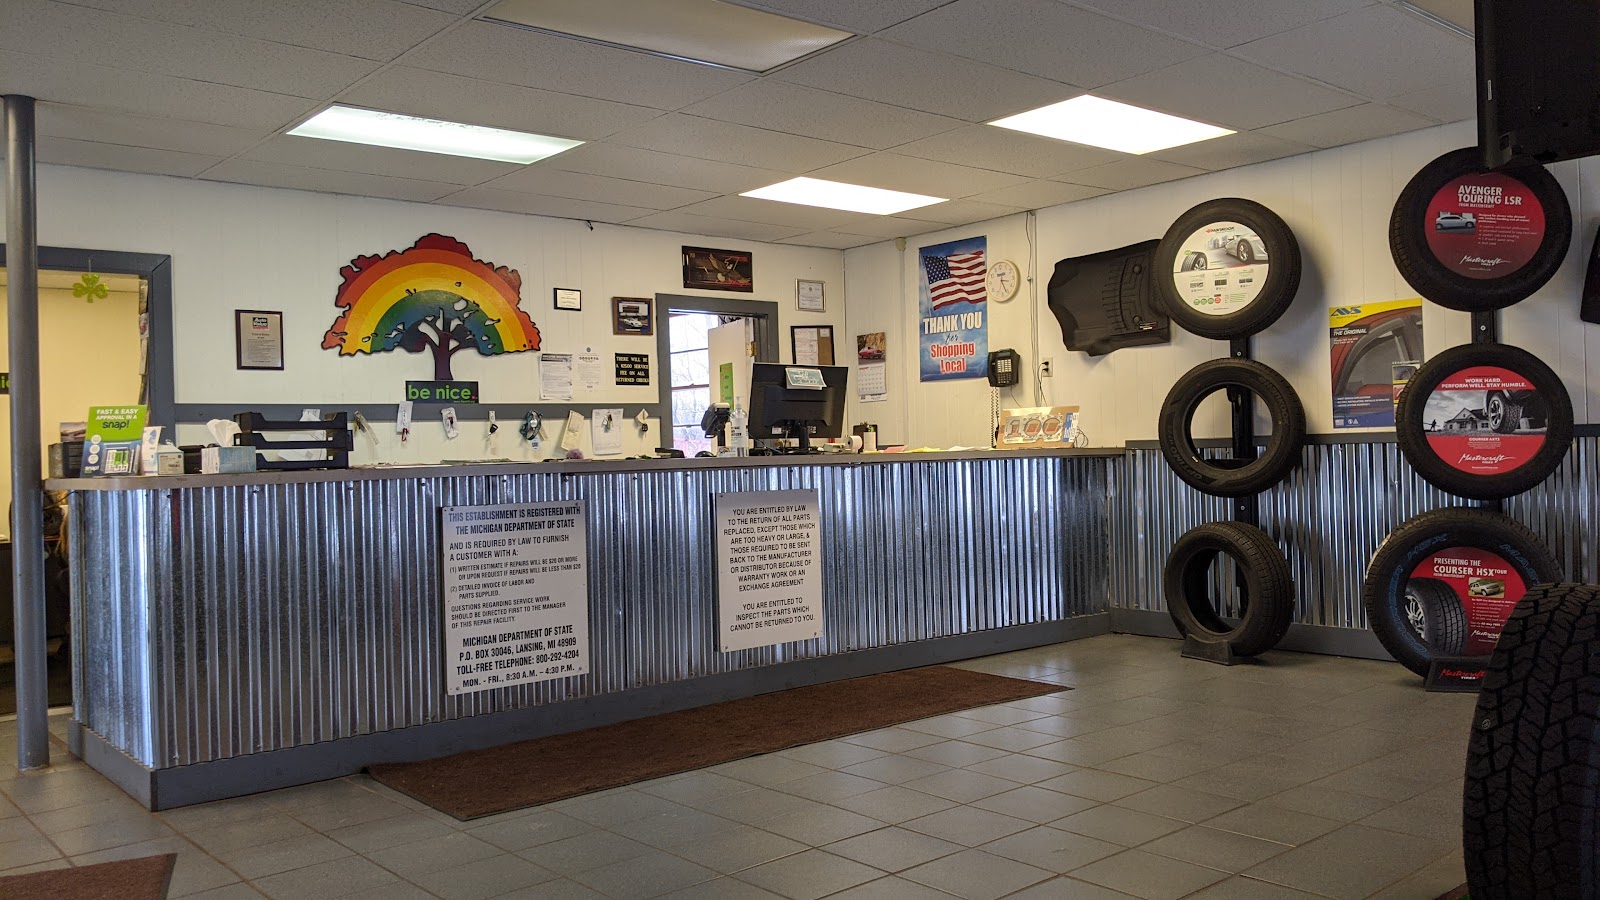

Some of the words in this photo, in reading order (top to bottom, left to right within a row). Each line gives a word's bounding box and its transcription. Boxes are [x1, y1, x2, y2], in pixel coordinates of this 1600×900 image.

[1458, 185, 1502, 196] AVENGER
[1458, 194, 1502, 204] TOURING
[1504, 196, 1522, 205] LSR
[1460, 254, 1510, 266] Mastercraft
[923, 314, 958, 334] THANK
[959, 311, 982, 330] YOU
[930, 342, 974, 359] Shopping
[940, 358, 966, 372] Local
[408, 384, 430, 399] be
[102, 420, 130, 430] snap!
[1458, 454, 1516, 464] Mastercraft
[449, 512, 463, 521] THIS
[465, 509, 517, 520] ESTABLISHMENT
[519, 508, 525, 517] IS
[526, 506, 563, 517] REGISTERED
[565, 506, 580, 515] WITH
[456, 525, 468, 534] THE
[470, 523, 502, 534] MICHIGAN
[504, 520, 545, 531] DEPARTMENT
[547, 520, 555, 528] OF
[556, 518, 574, 528] STATE
[723, 527, 755, 535] REPLACED,
[449, 542, 463, 550] AND
[473, 539, 506, 548] REQUIRED
[542, 534, 569, 543] FURNISH
[750, 544, 778, 552] REQUIRED
[456, 550, 492, 560] CUSTOMER
[494, 549, 510, 557] WITH
[768, 550, 811, 560] MANUFACTURER
[740, 562, 777, 572] DISTRIBUTOR
[778, 560, 803, 568] BECAUSE
[1434, 558, 1469, 566] PRESENTING
[1434, 566, 1473, 575] COURSER
[738, 573, 769, 582] WARRANTY
[738, 582, 769, 591] EXCHANGE
[770, 578, 803, 588] AGREEMENT
[451, 603, 480, 612] QUESTIONS
[482, 600, 511, 608] REGARDING
[768, 598, 793, 607] ENTITLED
[482, 608, 506, 616] DIRECTED
[735, 612, 759, 620] INSPECT
[773, 608, 790, 616] PARTS
[730, 622, 753, 631] CANNOT
[764, 617, 793, 626] RETURNED
[462, 634, 496, 647] MICHIGAN
[498, 628, 542, 642] DEPARTMENT
[544, 627, 552, 636] OF
[554, 624, 572, 635] STATE
[459, 651, 473, 661] P.O.
[475, 649, 489, 659] BOX
[491, 645, 513, 658] 30046,
[516, 641, 545, 654] LANSING,
[547, 640, 555, 648] MI
[557, 637, 576, 647] 48909
[456, 661, 492, 675] TOLL-FREE
[495, 655, 534, 669] TELEPHONE:
[536, 649, 578, 663] 800-292-4204
[462, 678, 480, 688] MON.
[506, 672, 520, 681] 8:30
[522, 669, 537, 678] A.M.
[545, 666, 558, 674] 4:30
[561, 663, 574, 672] P.M.
